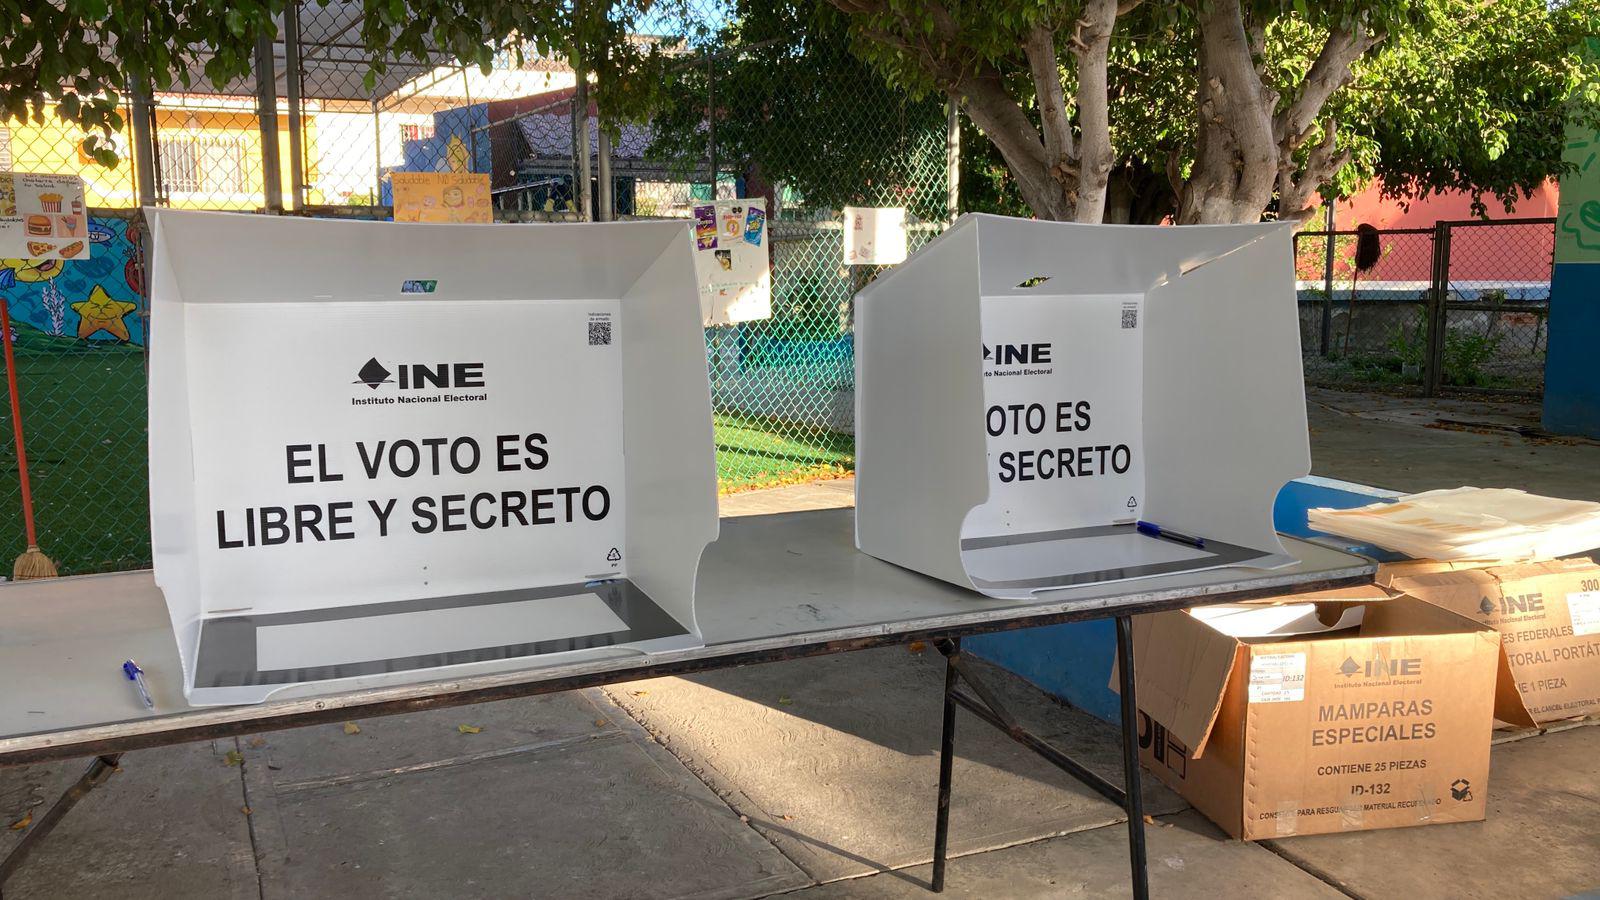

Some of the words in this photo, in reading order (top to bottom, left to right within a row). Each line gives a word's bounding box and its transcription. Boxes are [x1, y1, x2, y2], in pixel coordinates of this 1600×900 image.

[995, 343, 1052, 365] INE
[398, 362, 485, 390] INE
[993, 369, 1022, 377] Nacional
[1023, 368, 1053, 376] Electoral
[351, 396, 395, 405] Instituto
[397, 394, 441, 404] Nacional
[443, 393, 487, 402] Electoral
[1056, 400, 1091, 432] ES
[285, 443, 344, 484] EL
[355, 435, 481, 480] VOTO
[496, 432, 550, 473] ES
[998, 444, 1131, 483] SECRETO
[216, 501, 356, 550] LIBRE
[367, 498, 398, 537] Y
[410, 484, 612, 534] SECRETO
[1498, 592, 1545, 615] INE
[1517, 625, 1574, 642] FEDERALES
[1364, 658, 1422, 678] INE
[1531, 681, 1536, 691] 1
[1538, 677, 1568, 690] PIEZA
[1318, 699, 1433, 722] MAMPARAS
[1541, 704, 1562, 713] CANCEL
[1563, 699, 1597, 709] ELECTORAL
[1312, 722, 1436, 747] ESPECIALES
[1317, 763, 1372, 776] CONTIENE
[1374, 762, 1387, 772] 25
[1389, 759, 1427, 771] PIEZAS
[1351, 783, 1391, 795] ID-132
[1297, 809, 1315, 817] PARA
[1363, 802, 1396, 811] MATERIAL
